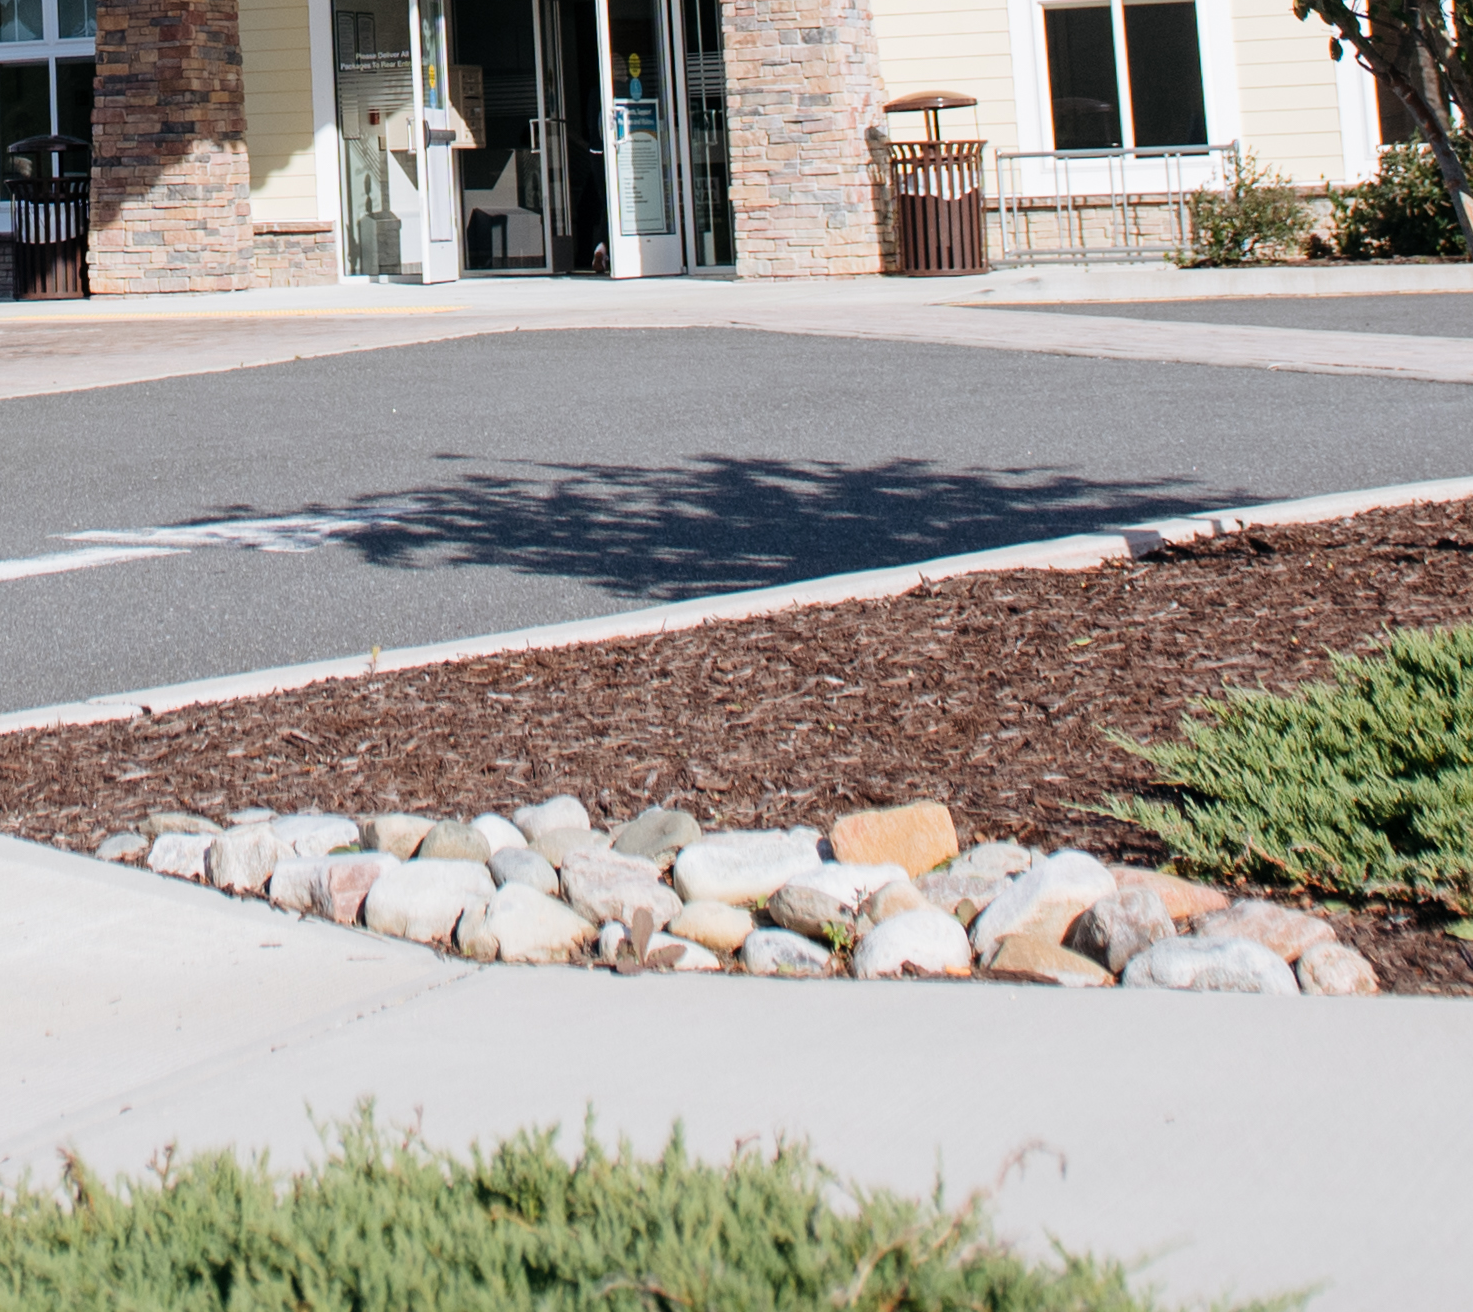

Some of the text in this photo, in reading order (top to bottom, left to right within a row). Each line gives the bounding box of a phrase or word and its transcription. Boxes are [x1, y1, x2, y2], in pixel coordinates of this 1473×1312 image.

[355, 50, 410, 61] Please Deliver All
[340, 62, 372, 72] Packages
[371, 61, 380, 69] To
